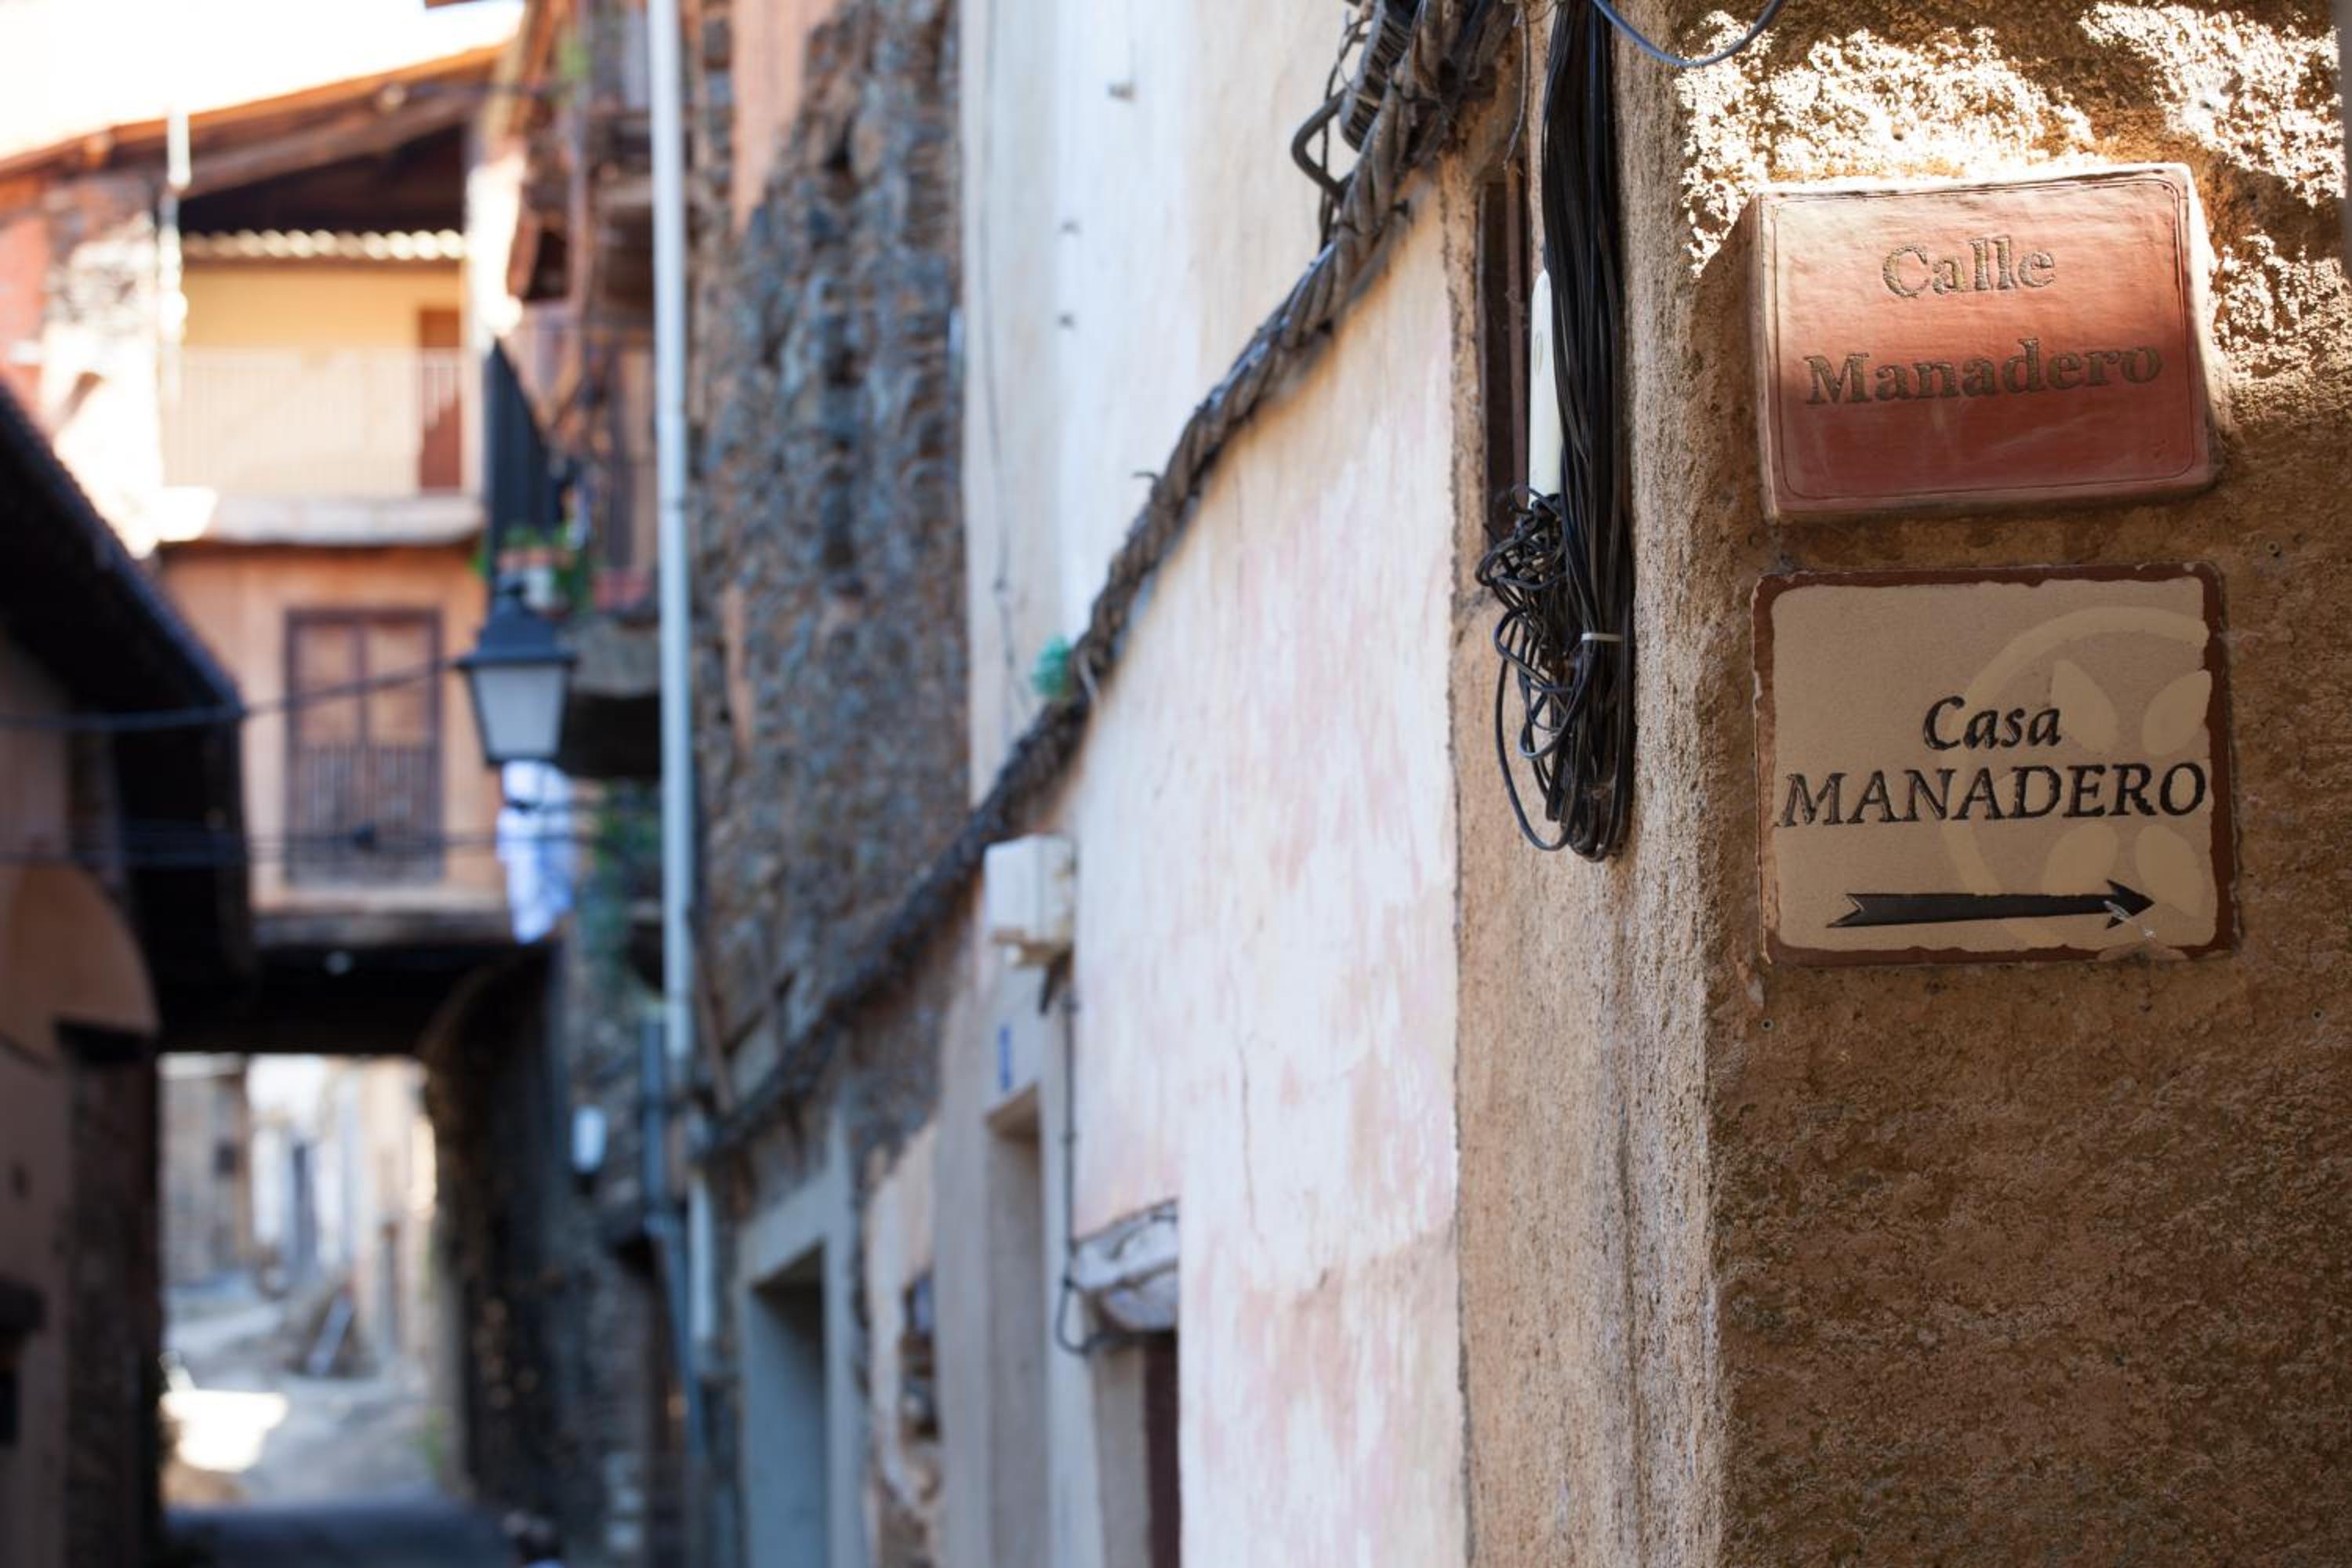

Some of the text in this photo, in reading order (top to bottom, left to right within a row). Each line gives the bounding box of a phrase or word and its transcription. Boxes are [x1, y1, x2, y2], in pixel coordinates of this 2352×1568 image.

[1882, 234, 2056, 298] Calle
[1805, 338, 2163, 405] Manadero
[1922, 695, 2061, 750] Casa
[1774, 762, 2206, 828] MANADERO
